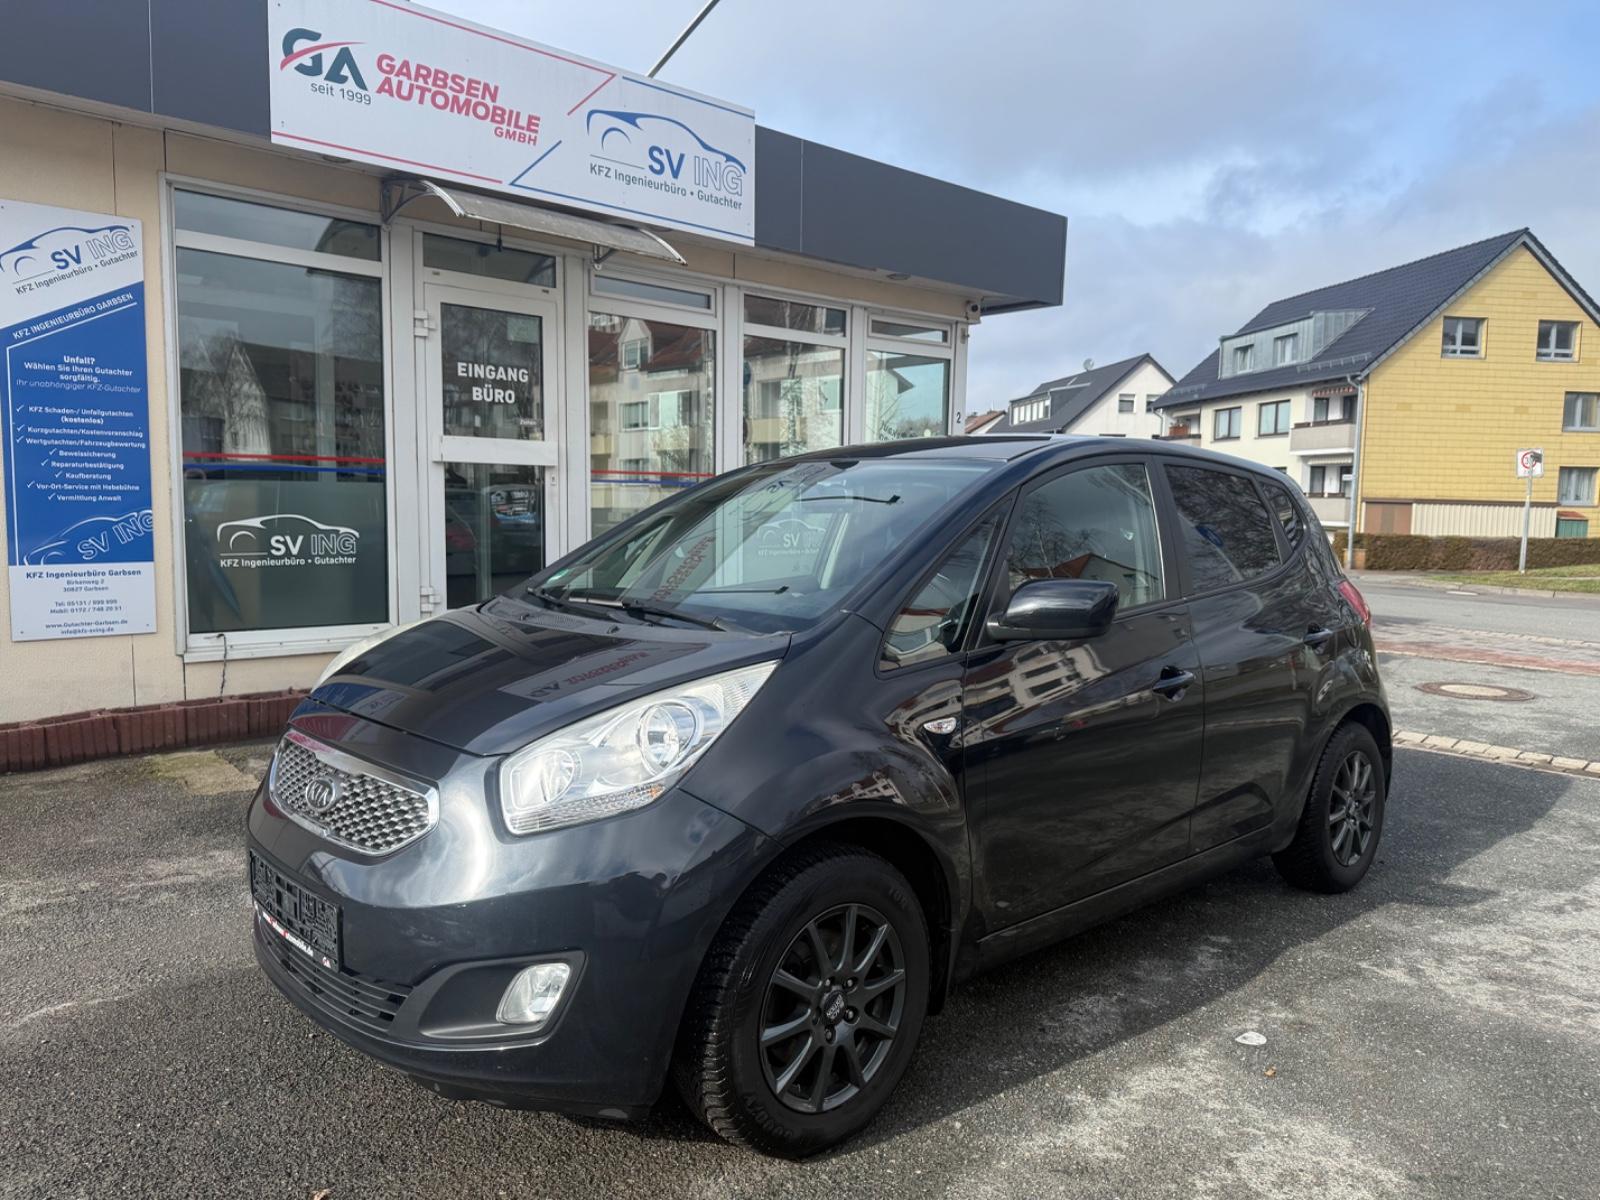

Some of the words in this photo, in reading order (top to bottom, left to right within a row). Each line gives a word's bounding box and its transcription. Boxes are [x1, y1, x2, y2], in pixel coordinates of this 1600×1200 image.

[376, 53, 499, 103] GARBSEN
[310, 81, 335, 97] seit
[340, 88, 372, 105] 1999
[376, 77, 541, 134] AUTOMOBILE
[493, 126, 538, 146] GMBH
[647, 145, 686, 180] SV
[693, 155, 743, 196] ING
[589, 163, 612, 178] KFZ
[614, 169, 687, 197] Ingenieurbüro
[697, 190, 743, 210] Gutachter
[50, 244, 82, 271] SV
[86, 230, 135, 260] ING
[15, 283, 34, 295] KFZ
[35, 263, 93, 290] Ingenieurbüro
[100, 250, 139, 268] Gutachter
[12, 328, 31, 341] KFZ
[30, 307, 96, 335] INGENIEURBÜRO
[96, 293, 134, 312] GARBSEN
[63, 355, 96, 365] Unfall?
[23, 361, 56, 372] Wählen
[57, 364, 71, 373] Sie
[72, 365, 94, 375] Ihren
[94, 367, 133, 377] Gutachter
[457, 362, 529, 383] EINGANG
[59, 373, 101, 383] sorgfältig.
[28, 380, 86, 392] unabhängiger
[86, 383, 141, 394] KFZ-Gutachter
[472, 383, 516, 404] BÜRO
[28, 406, 44, 414] KFZ
[81, 408, 134, 418] Unfallgutachten
[956, 411, 962, 424] 2
[60, 416, 104, 425] (kostenlos)
[58, 450, 117, 459] Beweissicherung
[50, 461, 125, 470] Reparaturbestätigung
[65, 472, 112, 481] Kaufberatung
[36, 482, 89, 491] Vor-Ort-Service
[56, 494, 97, 502] Vermittlung
[77, 531, 109, 561] SV
[112, 510, 154, 544] ING
[783, 532, 800, 549] SV
[270, 535, 304, 556] SV
[310, 533, 357, 555] ING
[220, 558, 240, 568] KFZ
[241, 557, 306, 569] Ingenieurbüro
[314, 556, 356, 565] Gutachter
[25, 571, 44, 579] KFZ
[45, 569, 107, 580] Ingenieurbüro
[107, 569, 142, 577] Garbsen
